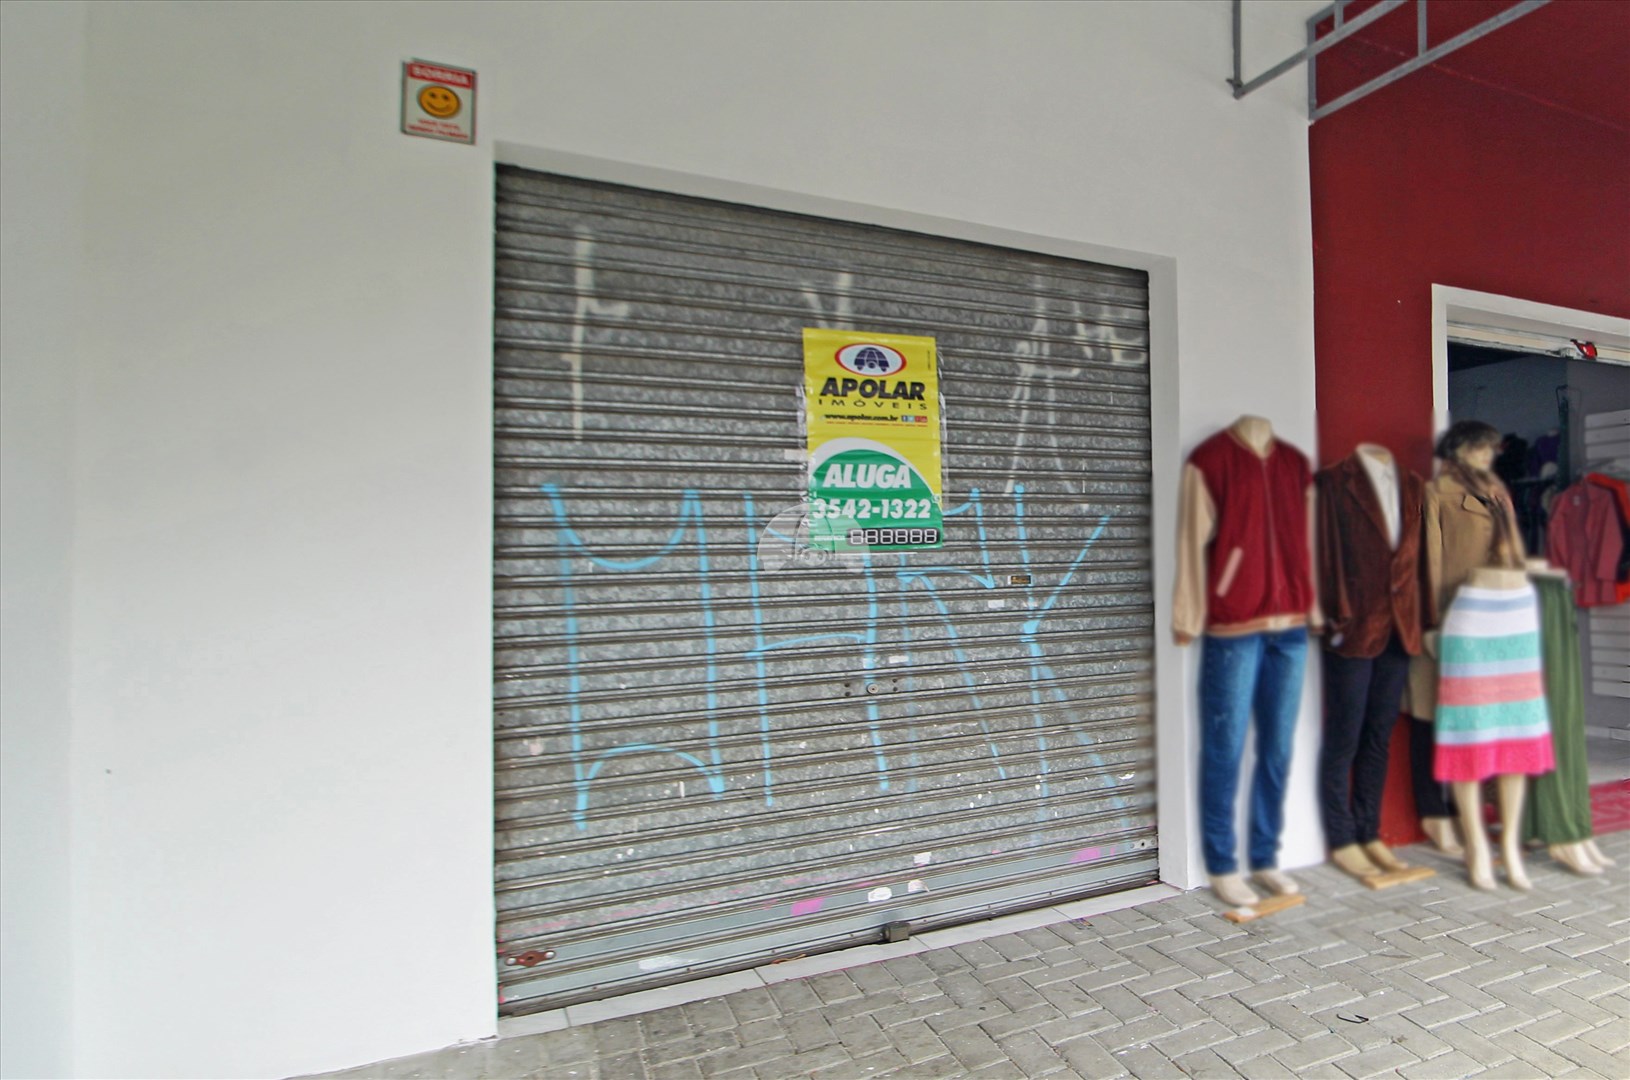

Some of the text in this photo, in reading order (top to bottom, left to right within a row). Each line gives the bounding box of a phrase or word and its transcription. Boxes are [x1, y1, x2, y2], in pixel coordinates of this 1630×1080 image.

[820, 376, 926, 401] APOLAR
[818, 398, 928, 411] IMÓVEIS
[824, 413, 899, 422] www.apolar.com.br
[822, 463, 912, 489] ALUGA
[812, 498, 932, 519] 3542-1322
